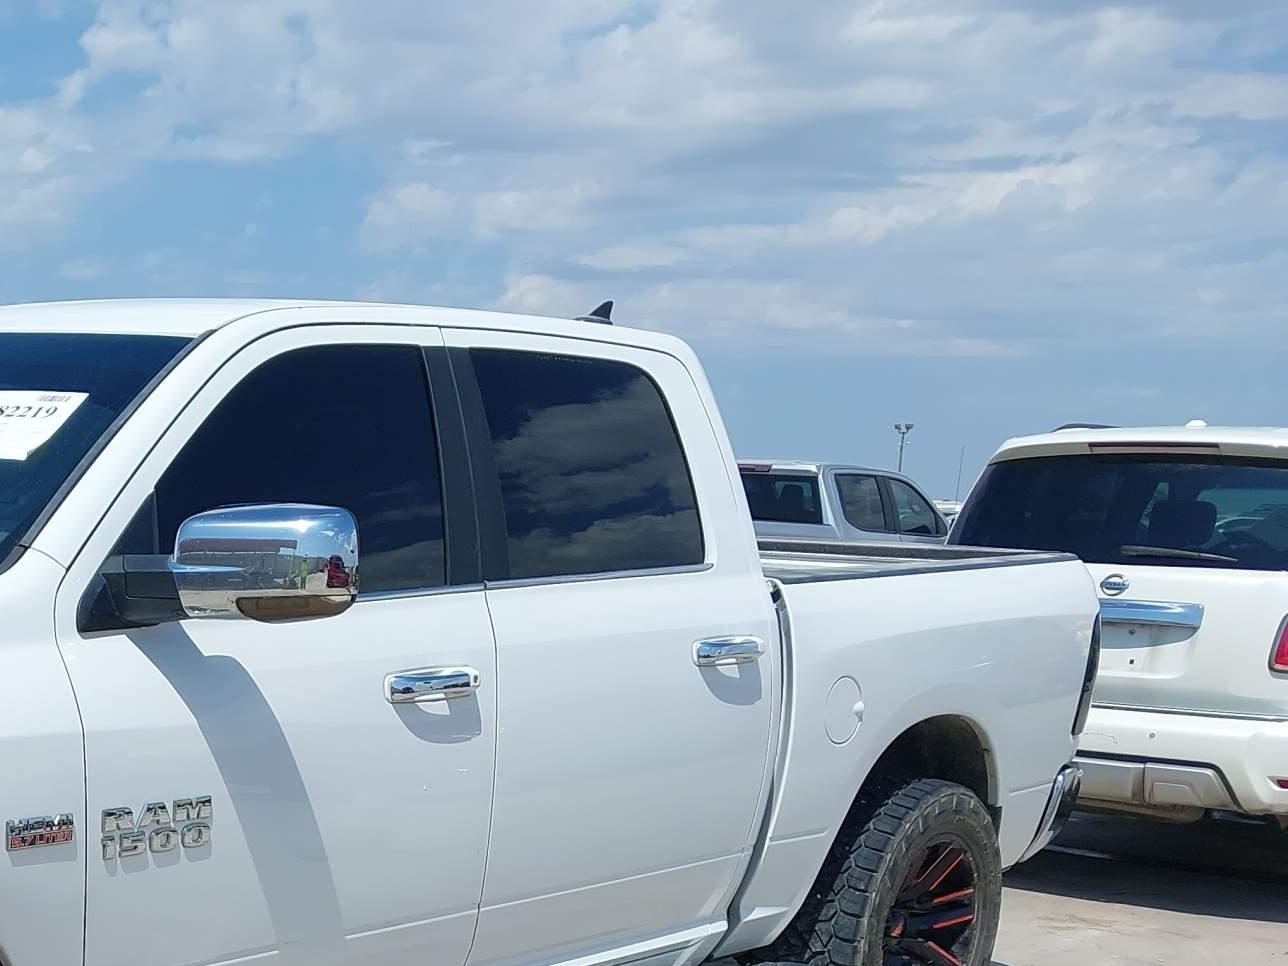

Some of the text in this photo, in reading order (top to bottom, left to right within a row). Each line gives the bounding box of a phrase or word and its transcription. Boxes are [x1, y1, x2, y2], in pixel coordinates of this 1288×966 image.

[6, 813, 74, 836] HEMI
[101, 795, 212, 833] RAM
[101, 822, 212, 861] 1500
